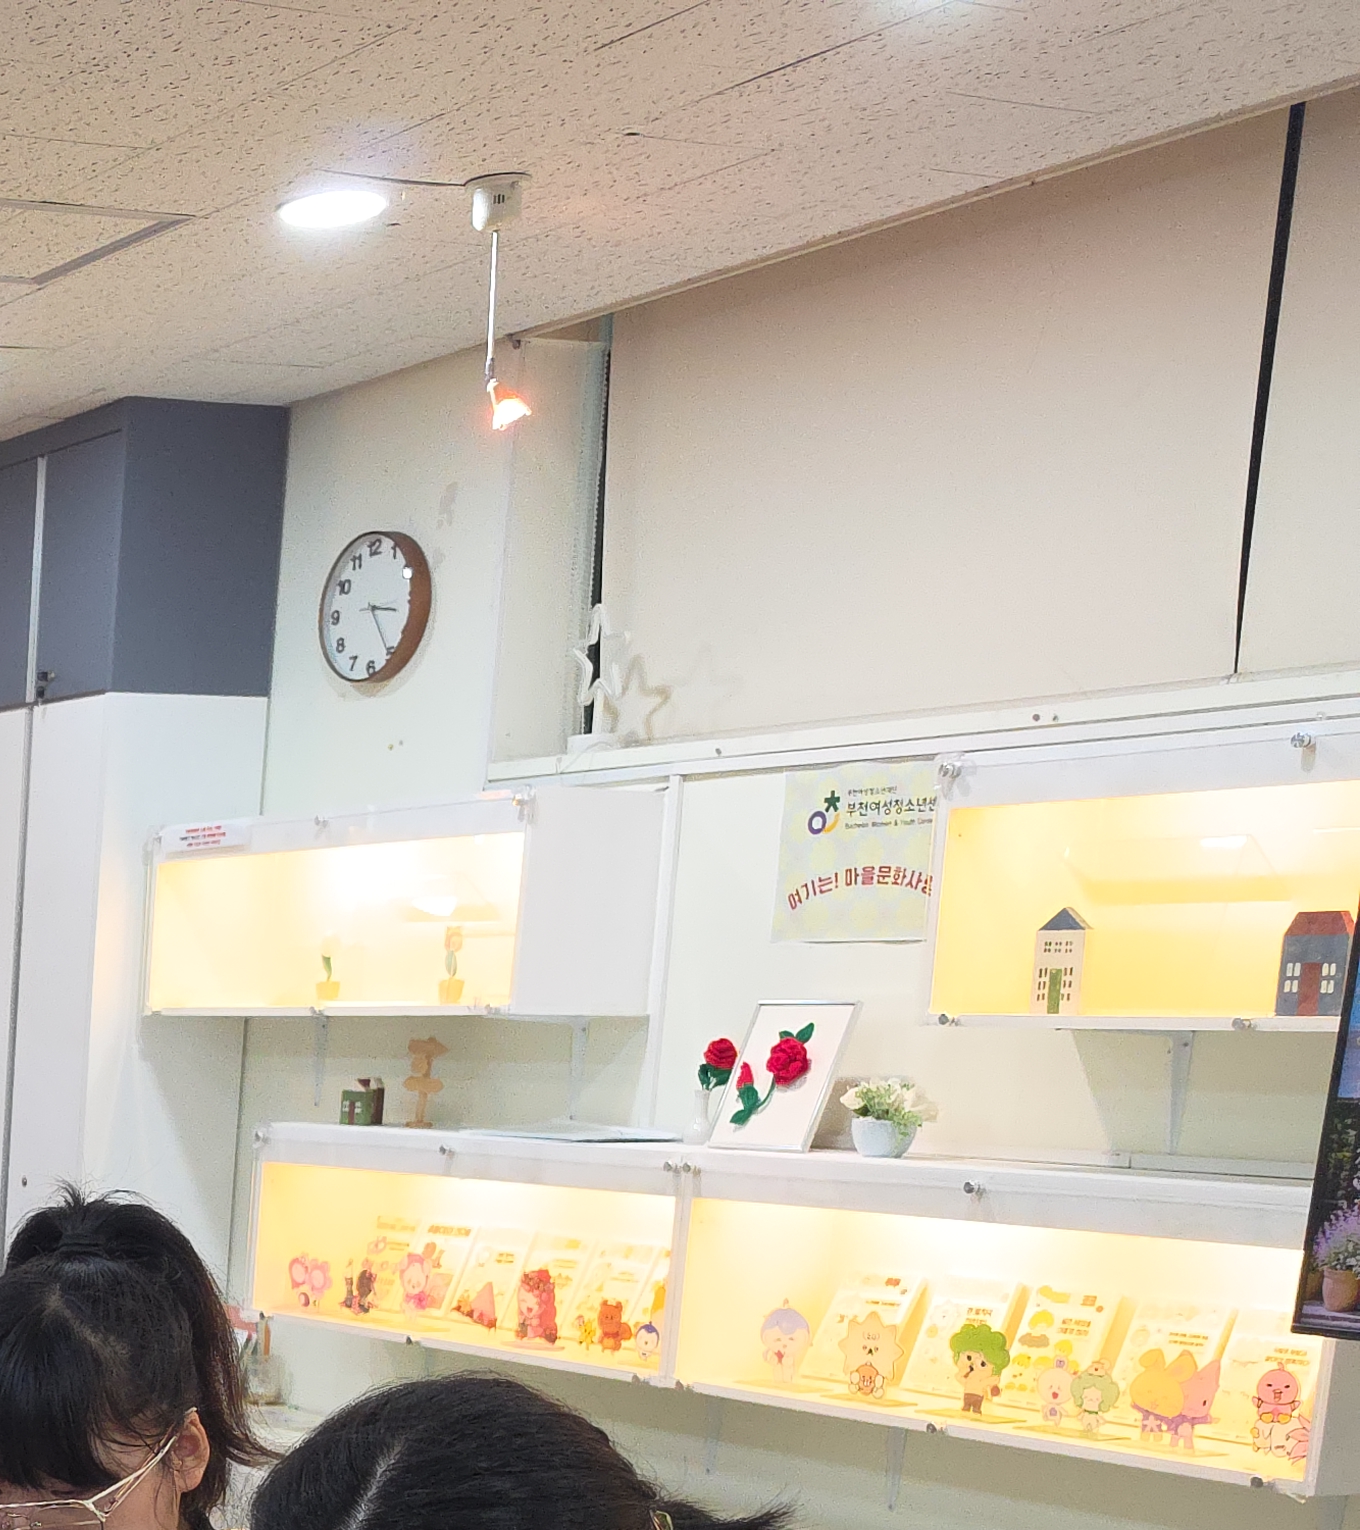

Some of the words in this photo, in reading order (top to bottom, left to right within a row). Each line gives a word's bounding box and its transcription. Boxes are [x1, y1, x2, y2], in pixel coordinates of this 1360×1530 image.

[367, 539, 382, 557] 12
[391, 543, 397, 559] 1
[350, 554, 362, 570] 11
[337, 579, 351, 595] 10
[331, 610, 340, 626] 9
[336, 637, 346, 653] 8
[349, 655, 358, 671] 7
[366, 661, 376, 677] 6
[787, 872, 839, 910] 여기는!
